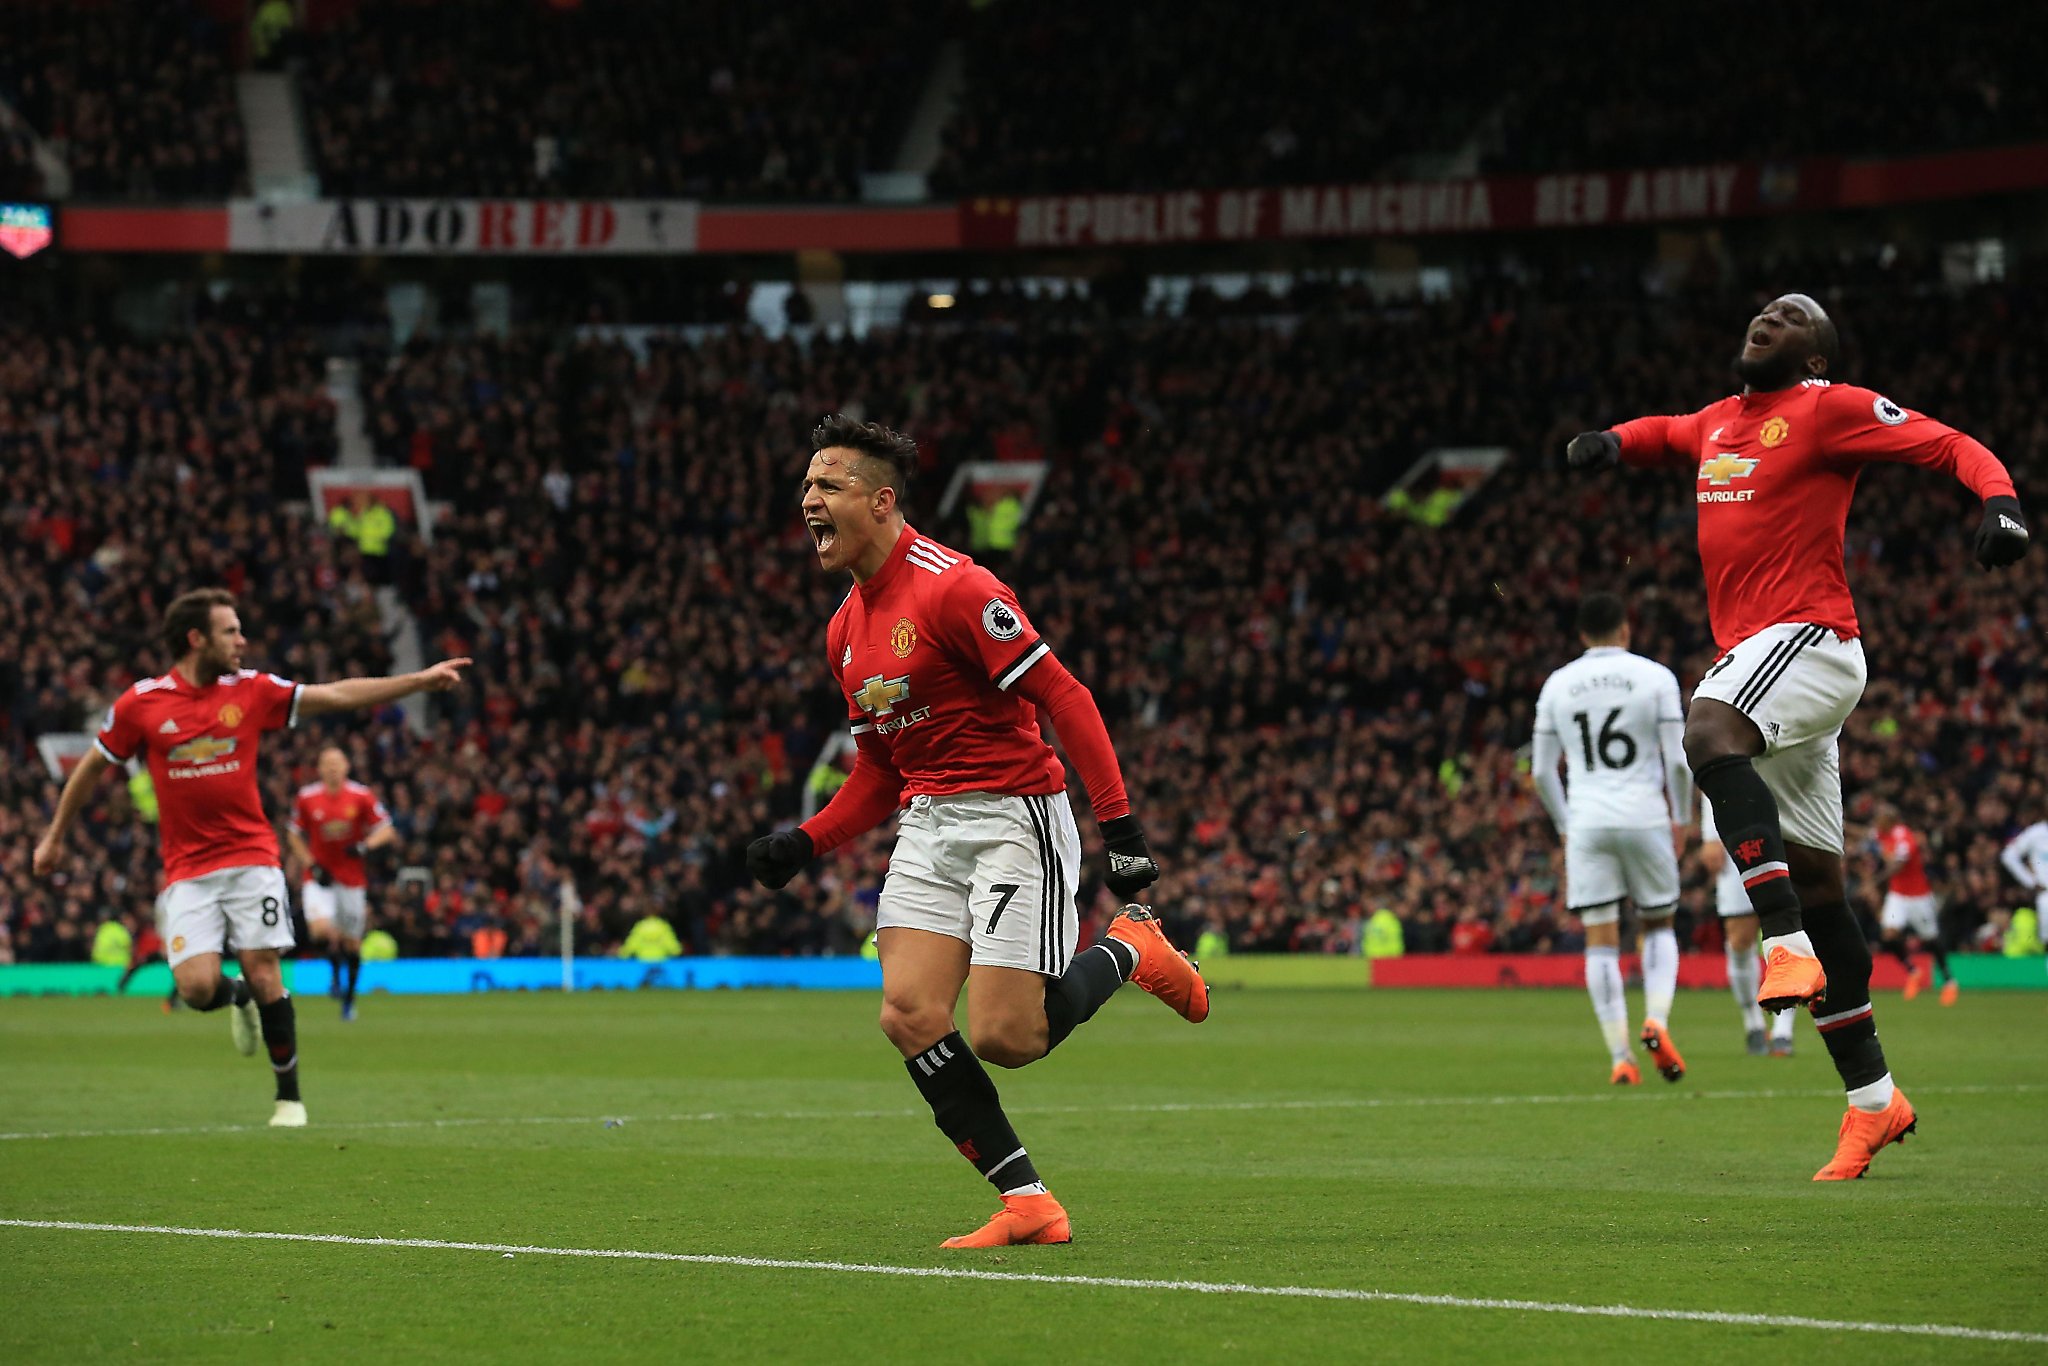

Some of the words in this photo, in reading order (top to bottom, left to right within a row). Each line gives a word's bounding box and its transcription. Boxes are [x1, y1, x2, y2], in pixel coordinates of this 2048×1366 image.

[322, 201, 618, 249] ADORED
[1017, 191, 1203, 246] REPUBLIC
[1216, 189, 1264, 239] OF
[1280, 181, 1494, 234] MANCUNIA
[1533, 174, 1611, 225] RED
[1622, 165, 1739, 219] ARMY
[1697, 489, 1755, 503] HEVROLET
[1573, 707, 1637, 772] 16
[262, 897, 279, 926] 8
[985, 884, 1020, 935] 7
